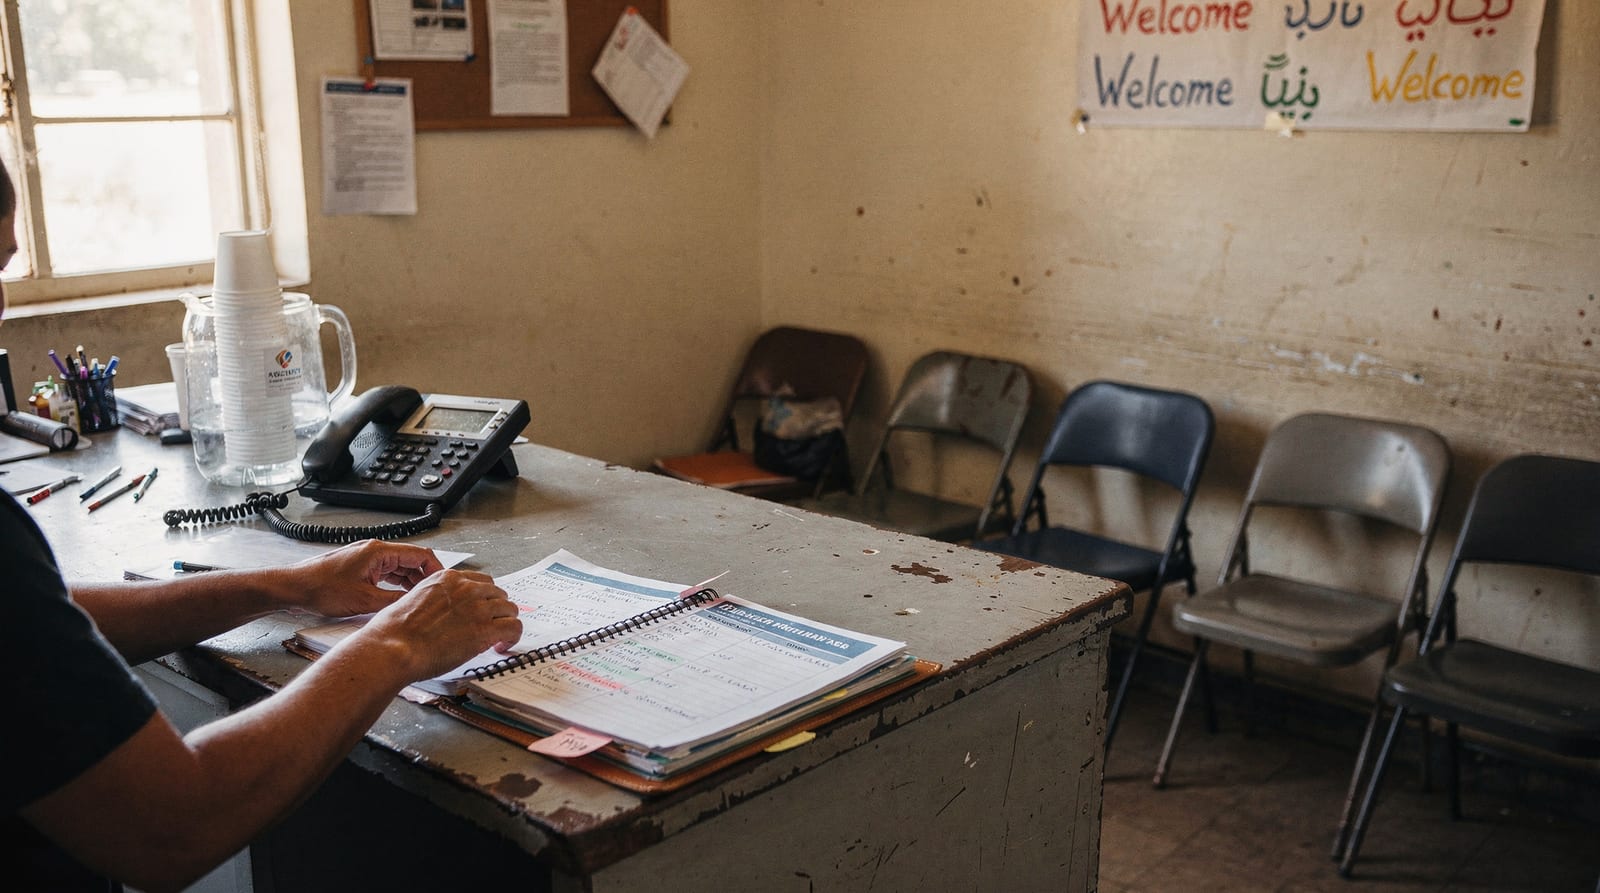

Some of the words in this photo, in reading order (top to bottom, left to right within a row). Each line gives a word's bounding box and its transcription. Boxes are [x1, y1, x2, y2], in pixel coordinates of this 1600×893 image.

[1099, 0, 1253, 35] Welcome
[1094, 52, 1233, 109] Welcome
[1366, 49, 1525, 103] Welcome
